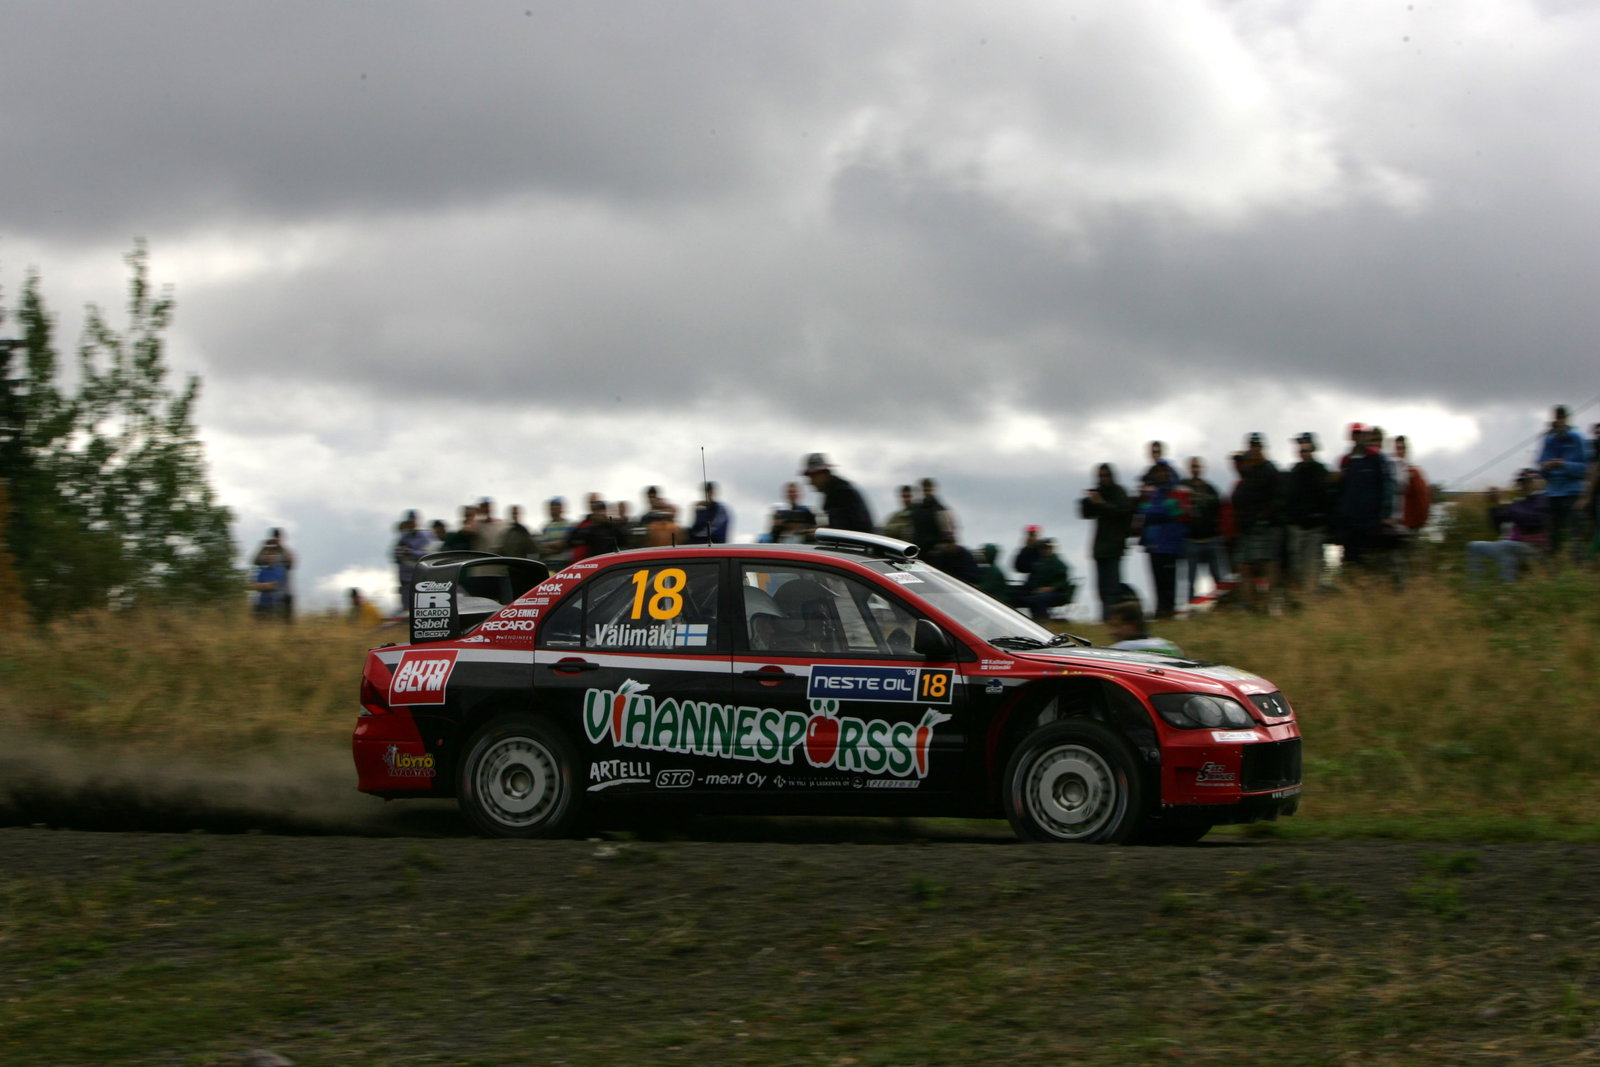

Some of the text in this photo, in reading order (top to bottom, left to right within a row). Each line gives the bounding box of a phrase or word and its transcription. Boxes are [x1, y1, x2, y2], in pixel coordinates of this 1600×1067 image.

[538, 583, 563, 592] NGK
[631, 568, 687, 620] 18
[415, 609, 449, 617] RICARDO
[517, 609, 539, 618] ENKEI
[413, 618, 449, 629] Sabelt
[480, 620, 535, 631] RECARO
[595, 623, 675, 646] Välimäki
[399, 659, 451, 676] AUTO
[394, 674, 445, 693] GLYM
[813, 675, 880, 691] NESTE
[883, 678, 912, 691] OIL
[922, 673, 947, 697] 18
[583, 679, 942, 779] VIHANNESPÖRSSI
[396, 753, 434, 768] LÖYTÖ
[590, 760, 651, 782] ARTELLI
[659, 772, 692, 785] STC
[705, 774, 743, 785] meat
[746, 773, 766, 787] Oy
